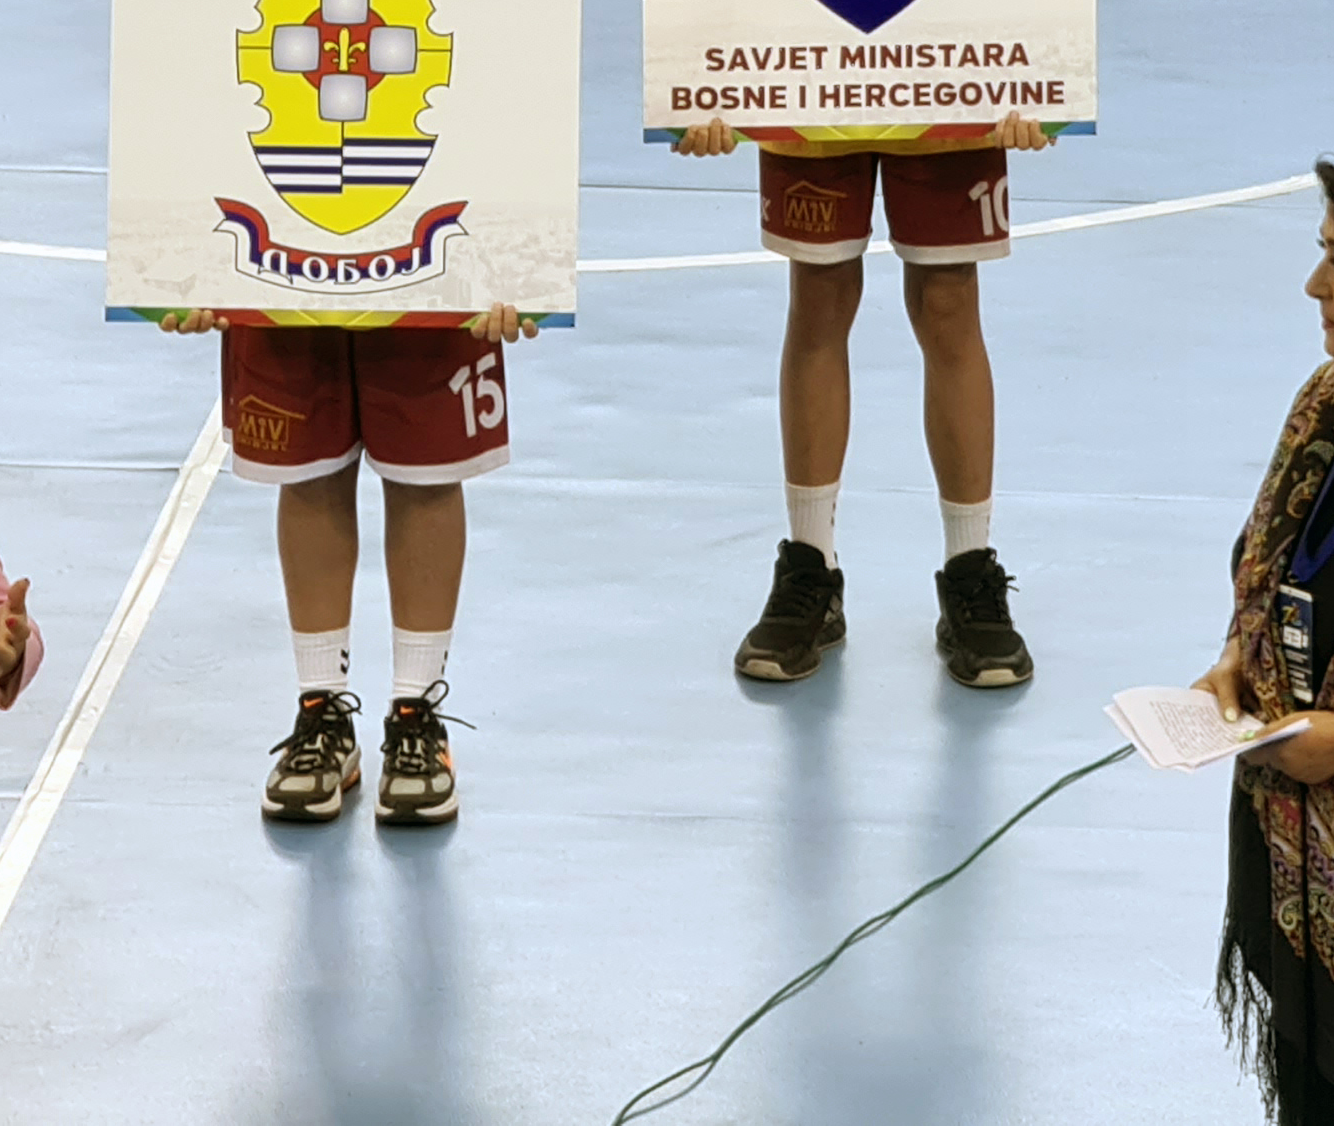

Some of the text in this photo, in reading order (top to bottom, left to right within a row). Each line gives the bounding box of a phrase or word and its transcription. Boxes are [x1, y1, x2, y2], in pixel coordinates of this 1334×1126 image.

[705, 43, 1030, 72] SAVJET MINISTARA
[671, 81, 1065, 111] BOSNE I HERCEGOVINE
[968, 175, 1010, 238] 10
[258, 247, 421, 285] ДОБОЈ
[448, 352, 506, 438] 15
